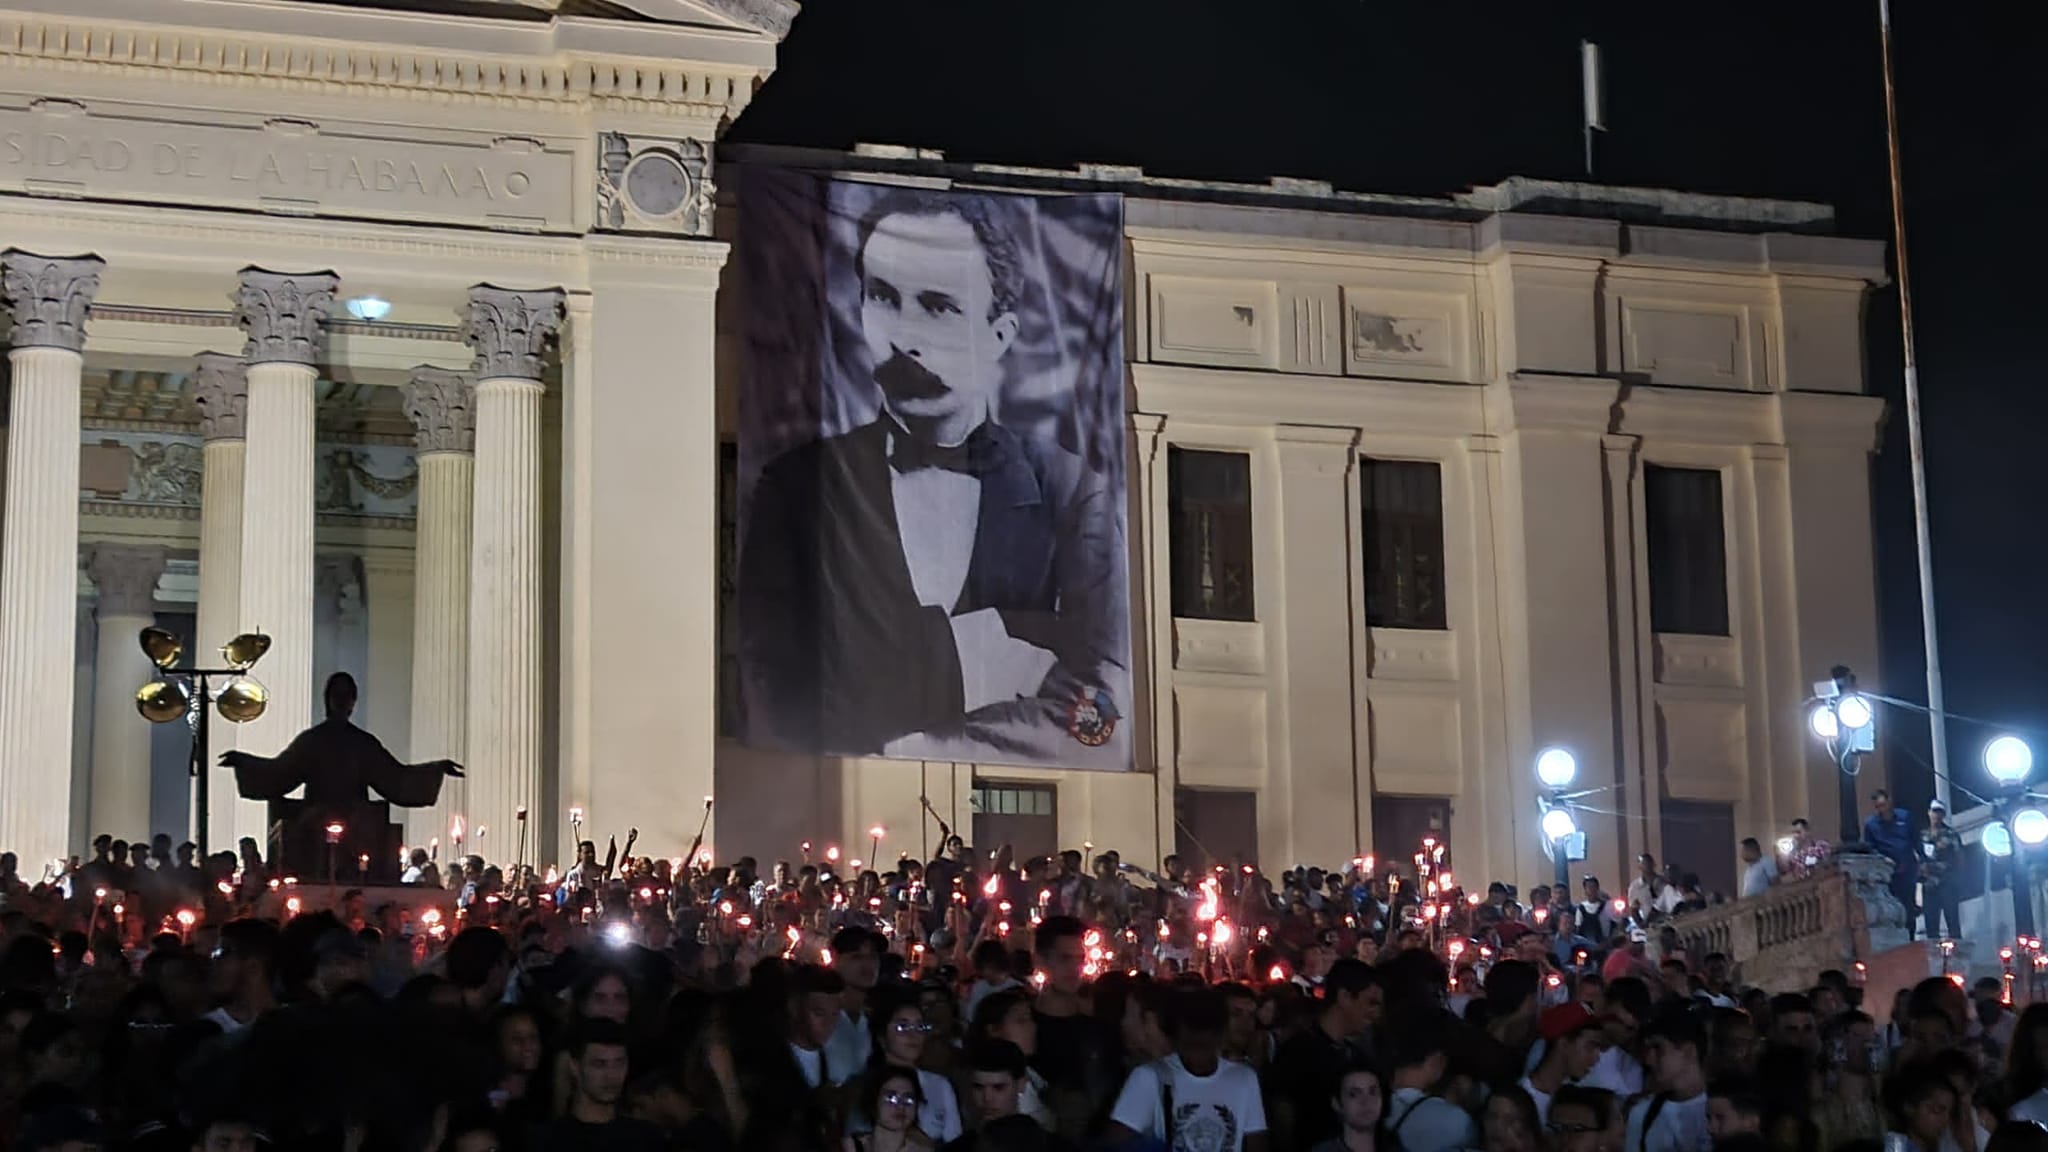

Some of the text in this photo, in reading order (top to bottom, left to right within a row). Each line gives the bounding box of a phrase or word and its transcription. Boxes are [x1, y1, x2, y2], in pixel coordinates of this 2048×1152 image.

[152, 140, 206, 177] DE
[229, 147, 288, 184] LA
[305, 152, 496, 200] HABANA
